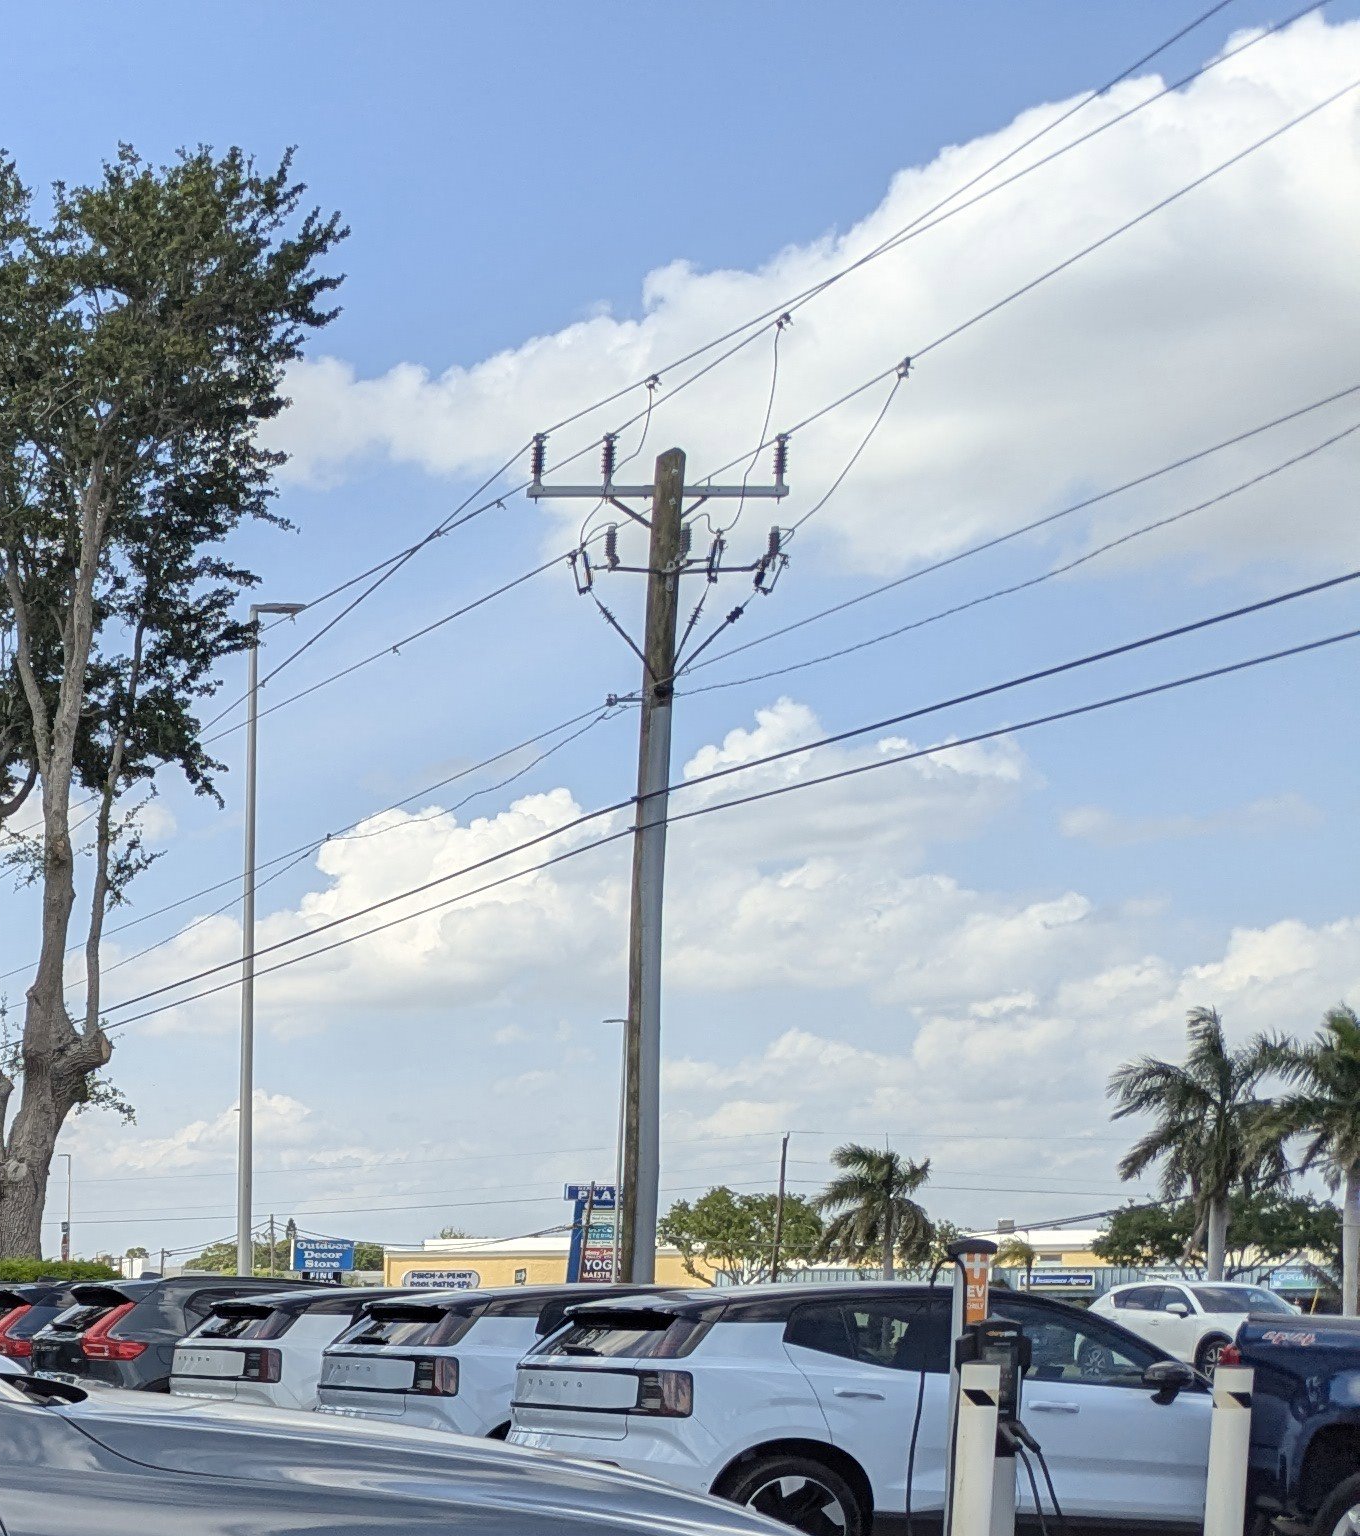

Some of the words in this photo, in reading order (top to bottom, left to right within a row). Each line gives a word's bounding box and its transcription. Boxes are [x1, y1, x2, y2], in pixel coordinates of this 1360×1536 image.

[303, 1250, 343, 1259] Decor
[304, 1259, 340, 1268] Store
[582, 1271, 620, 1279] MAESTR
[966, 1284, 984, 1298] EV
